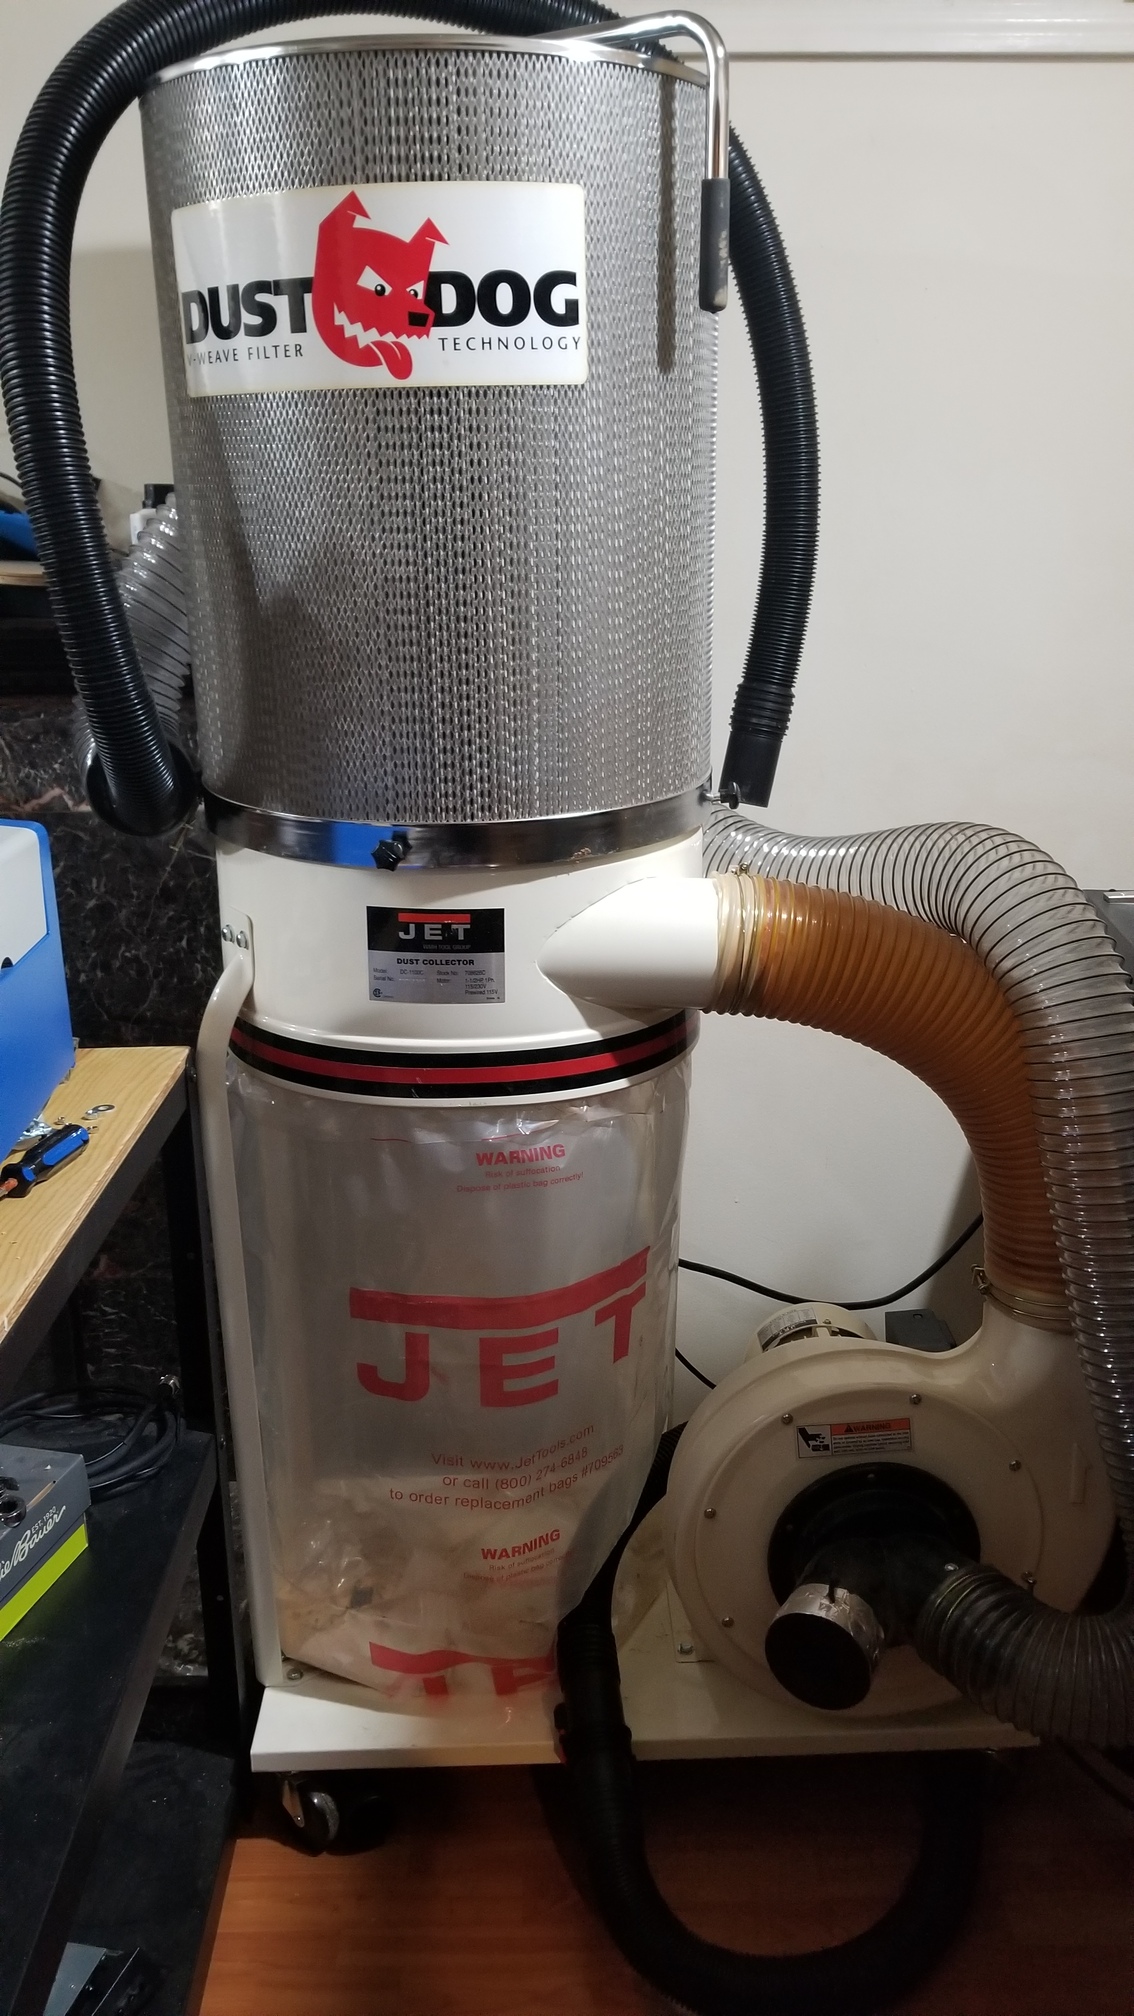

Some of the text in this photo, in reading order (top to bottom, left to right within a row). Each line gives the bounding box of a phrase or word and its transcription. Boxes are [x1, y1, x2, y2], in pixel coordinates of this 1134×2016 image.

[181, 269, 580, 345] DUST DOG
[187, 344, 304, 366] V-WEAVE FILTER
[438, 336, 582, 352] TECHNOLOGY
[398, 923, 471, 940] JET
[396, 957, 475, 966] DUST COLLECTOR
[476, 1144, 565, 1166] WARNING
[486, 1166, 561, 1179] Risk of suffocation
[456, 1185, 491, 1194] Dispose
[493, 1183, 501, 1191] of
[503, 1180, 531, 1190] plastic
[533, 1179, 548, 1188] bag
[357, 1281, 646, 1408] JET
[853, 1422, 891, 1432] WARNING
[431, 1424, 595, 1471] Visit www.JetTools.com
[390, 1444, 625, 1511] to order replacement bags #709563
[442, 1446, 588, 1492] or call (800) 274-6848
[12, 1505, 66, 1566] Bauer
[481, 1529, 561, 1560] WARNING
